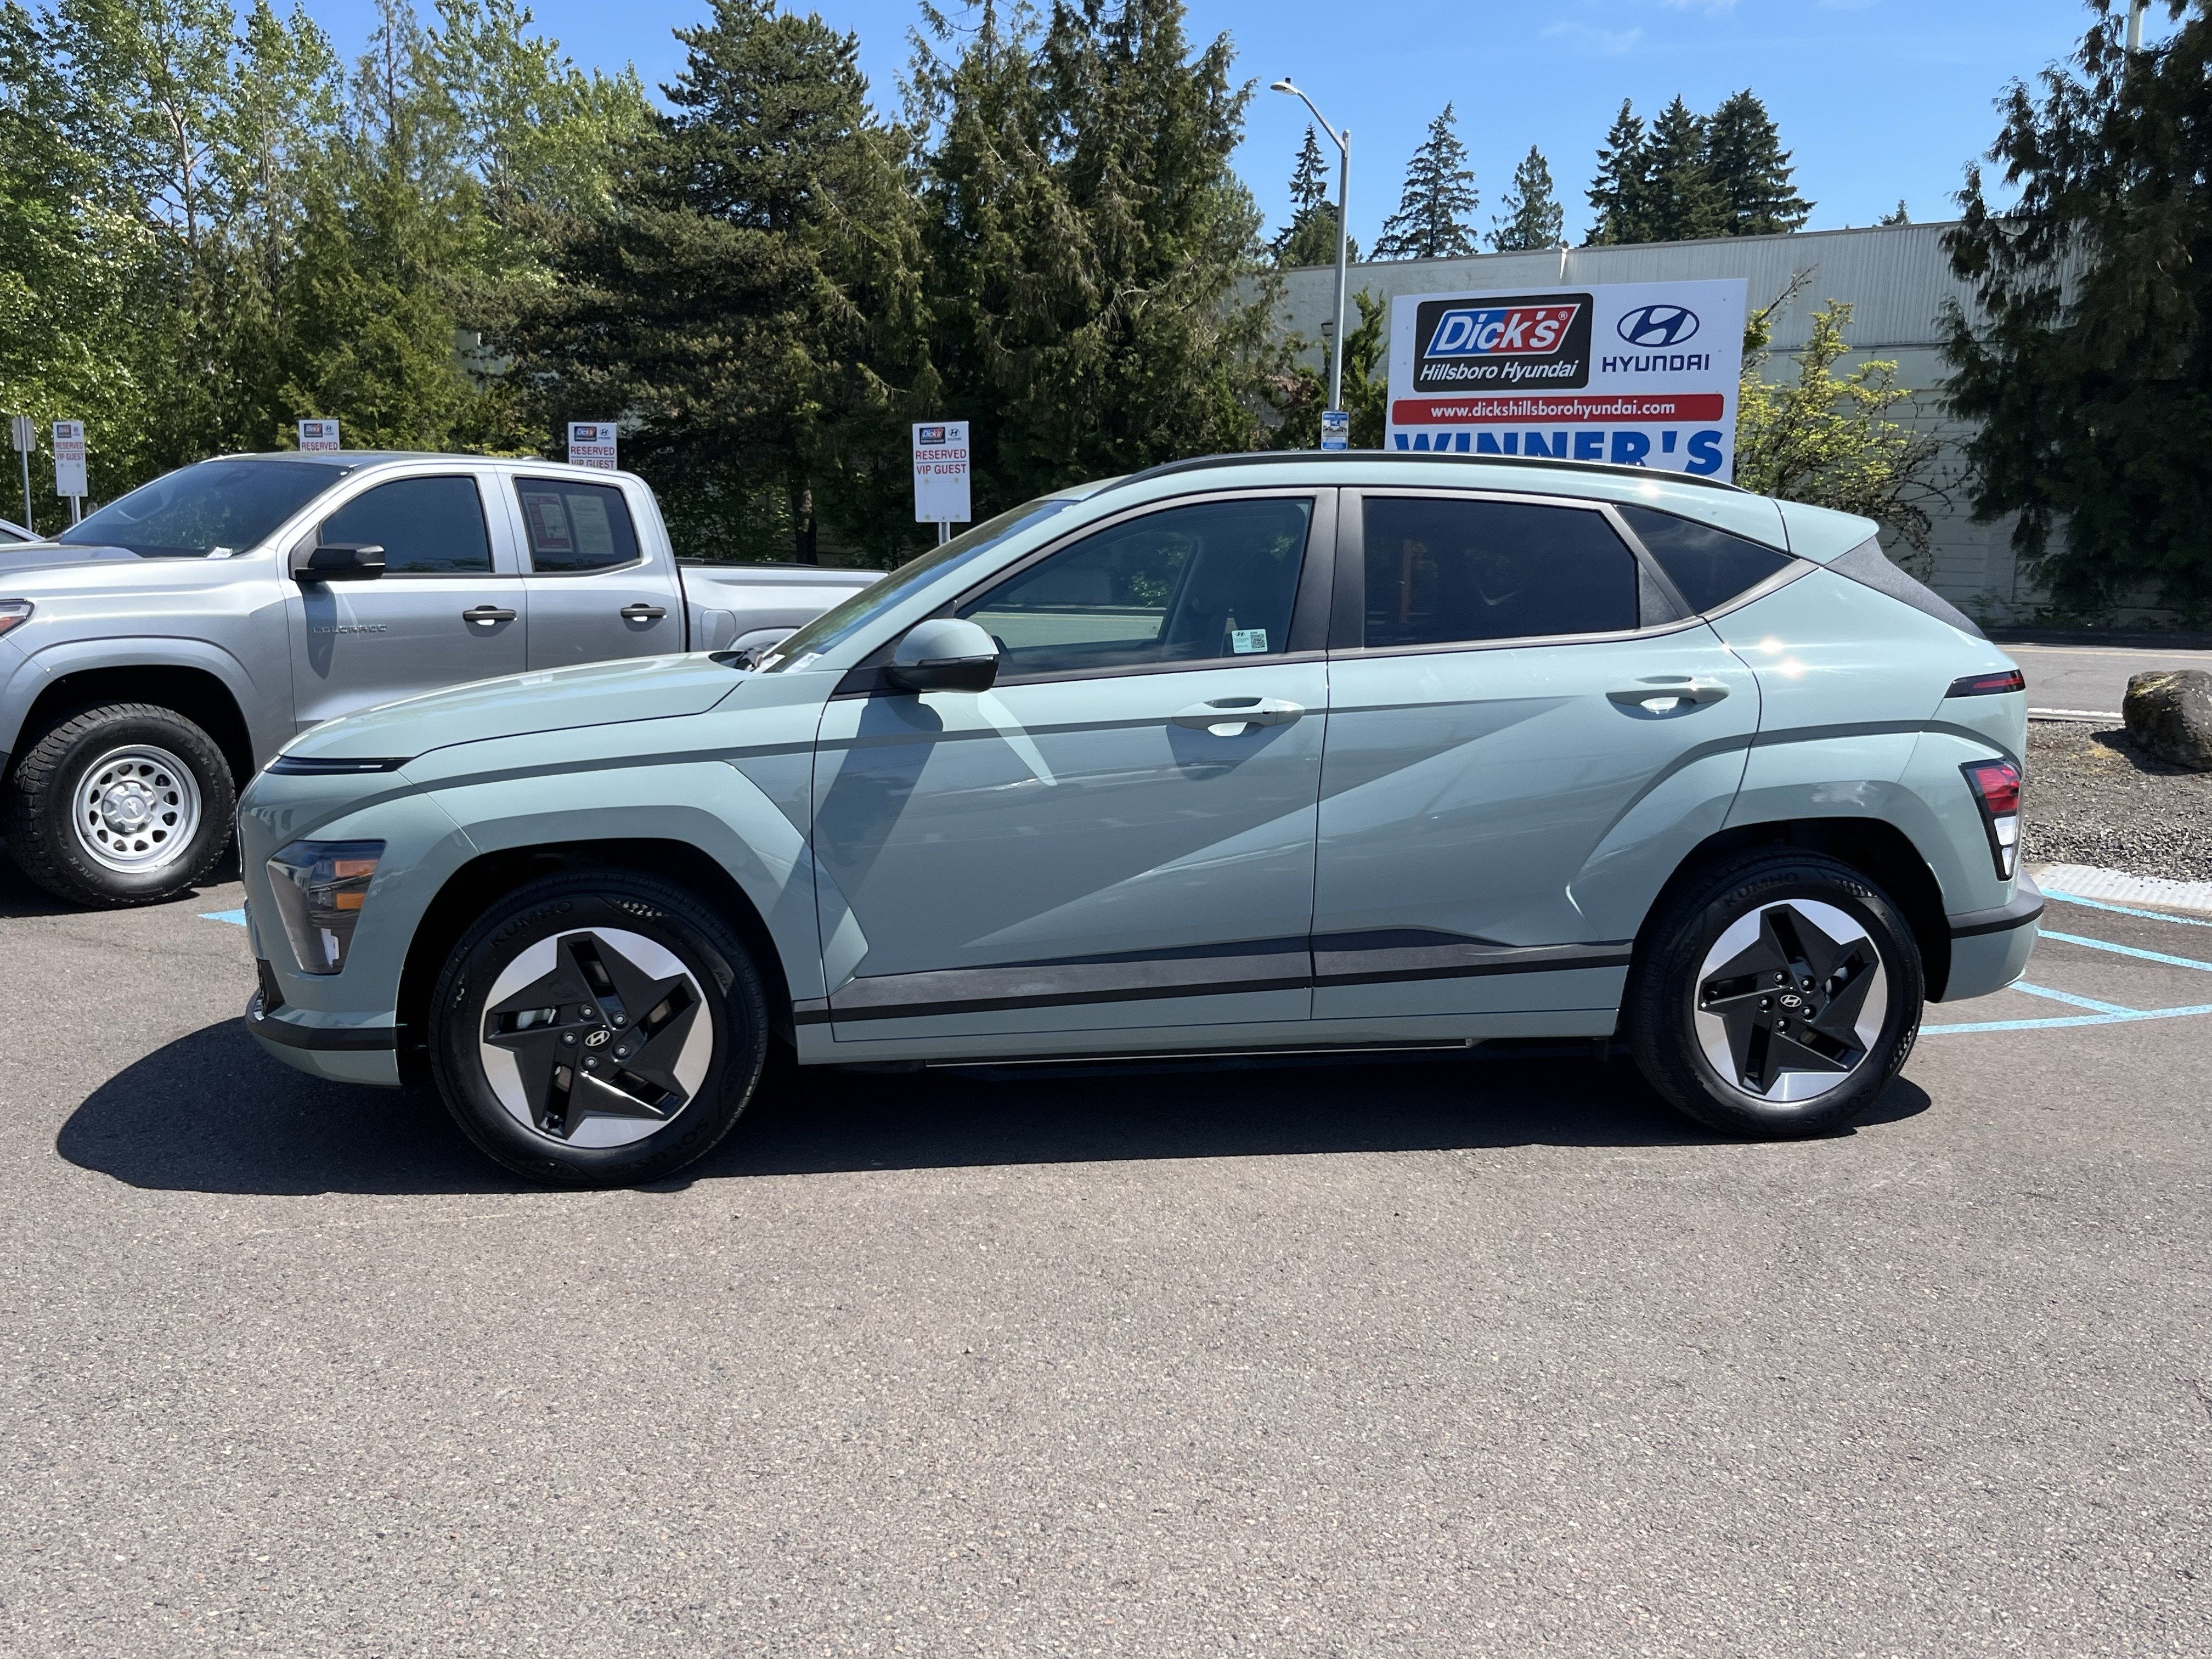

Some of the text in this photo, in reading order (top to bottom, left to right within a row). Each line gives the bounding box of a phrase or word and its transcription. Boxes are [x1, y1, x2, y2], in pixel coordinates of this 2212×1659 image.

[1436, 311, 1560, 351] Dick's
[1420, 359, 1579, 383] Hillsboro Hyundai
[1602, 354, 1709, 373] HYUNDAI
[1431, 399, 1675, 419] www.dickshillsborohyundai.com
[301, 442, 338, 450] RESERVED
[571, 446, 614, 455] RESERVED
[915, 449, 967, 460] RESERVED
[586, 460, 614, 469] GUEST
[917, 464, 967, 475] VIP GUEST
[1724, 871, 1799, 908] KUMHO
[490, 900, 573, 948] KUMHO
